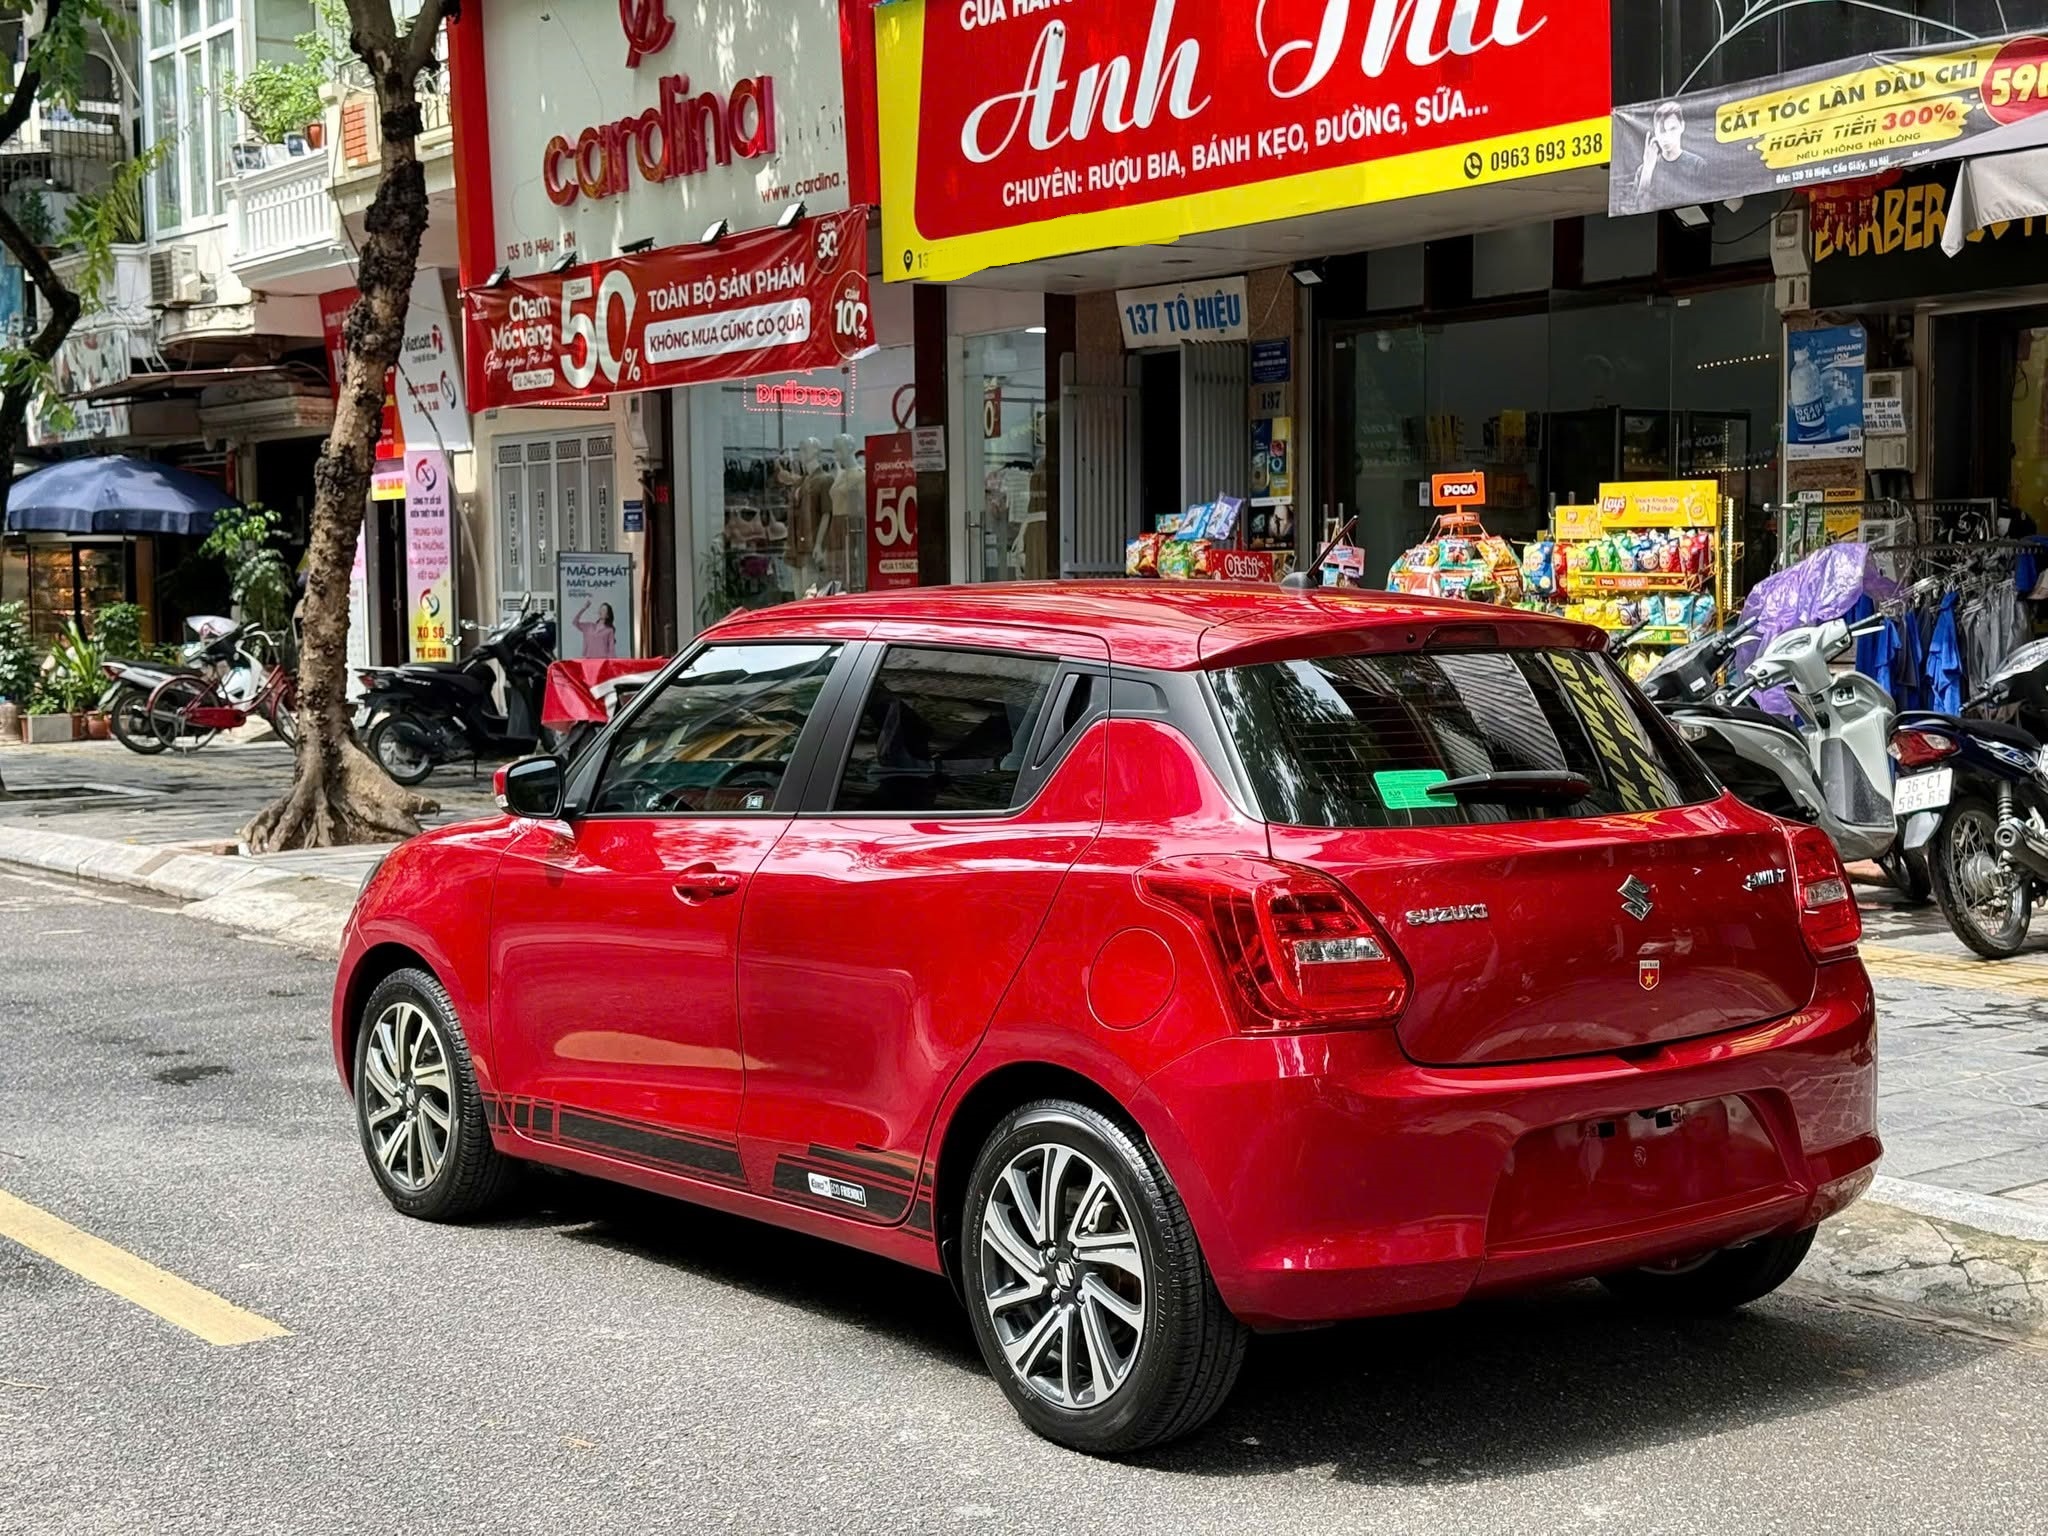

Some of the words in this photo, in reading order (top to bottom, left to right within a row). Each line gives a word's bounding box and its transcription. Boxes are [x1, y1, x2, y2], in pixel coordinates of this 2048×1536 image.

[961, 0, 1211, 163] Anh
[1721, 106, 1760, 134] CẮT
[1768, 97, 1810, 122] TÓC
[1819, 85, 1865, 111] LẦN
[1875, 71, 1925, 98] ĐẦU
[1935, 54, 1978, 84] CHỈ
[1002, 166, 1083, 207] CHUYÊN:
[1088, 155, 1142, 191] RƯỢU
[1147, 150, 1187, 181] BIA,
[1192, 133, 1251, 171] BÁNH
[1257, 122, 1309, 161] KẸO,
[1315, 101, 1408, 147] ĐƯỜNG,
[1415, 86, 1490, 127] SỮA...
[1769, 127, 1824, 152] HOÀN
[1833, 115, 1877, 140] TIỀN
[1882, 101, 1957, 131] 300%
[1796, 149, 1819, 160] NẾU
[1823, 141, 1864, 156] KHÔNG
[1889, 131, 1922, 146] LÒNG
[1490, 148, 1530, 172] 0963
[1536, 138, 1567, 164] 693
[1572, 132, 1604, 158] 338
[523, 240, 533, 257] Tô
[563, 231, 576, 248] HN
[648, 281, 690, 313] TOÀN
[693, 273, 716, 309] BỘ
[719, 267, 752, 300] SẢN
[755, 256, 805, 294] PHẨM
[650, 329, 690, 353] KHÔNG
[692, 328, 719, 347] MUA
[720, 318, 753, 343] CŨNG
[756, 313, 775, 338] CÓ
[777, 307, 805, 337] QUÀ
[1126, 303, 1158, 335] 137
[1164, 293, 1190, 332] TÔ
[1194, 289, 1241, 334] HIỆU
[1443, 484, 1476, 497] POCA
[1224, 554, 1259, 578] Oishi
[1405, 903, 1489, 926] SUZUKI
